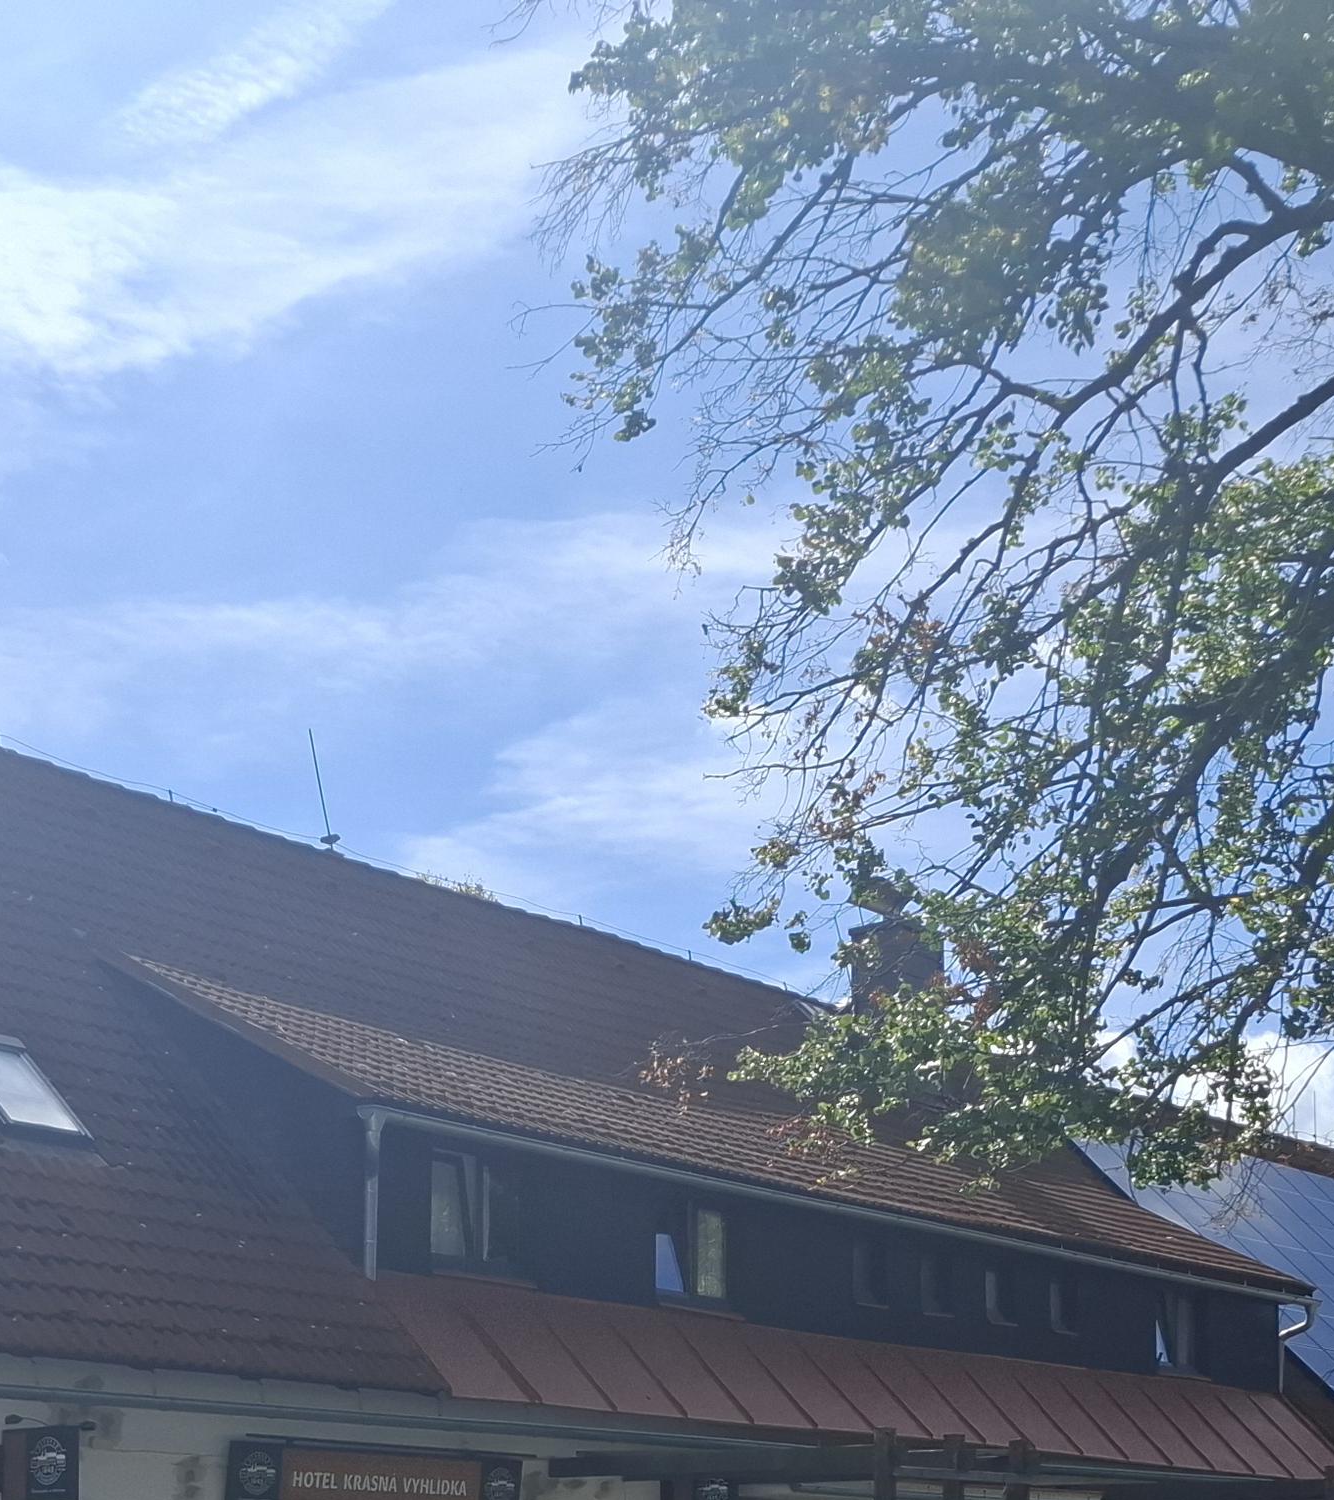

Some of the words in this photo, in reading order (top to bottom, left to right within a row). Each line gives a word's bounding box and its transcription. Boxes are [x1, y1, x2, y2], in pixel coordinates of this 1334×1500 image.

[292, 1471, 338, 1489] HOTEL
[343, 1472, 398, 1492] KRÁSNÁ
[403, 1476, 467, 1496] VYHLÍDKA
